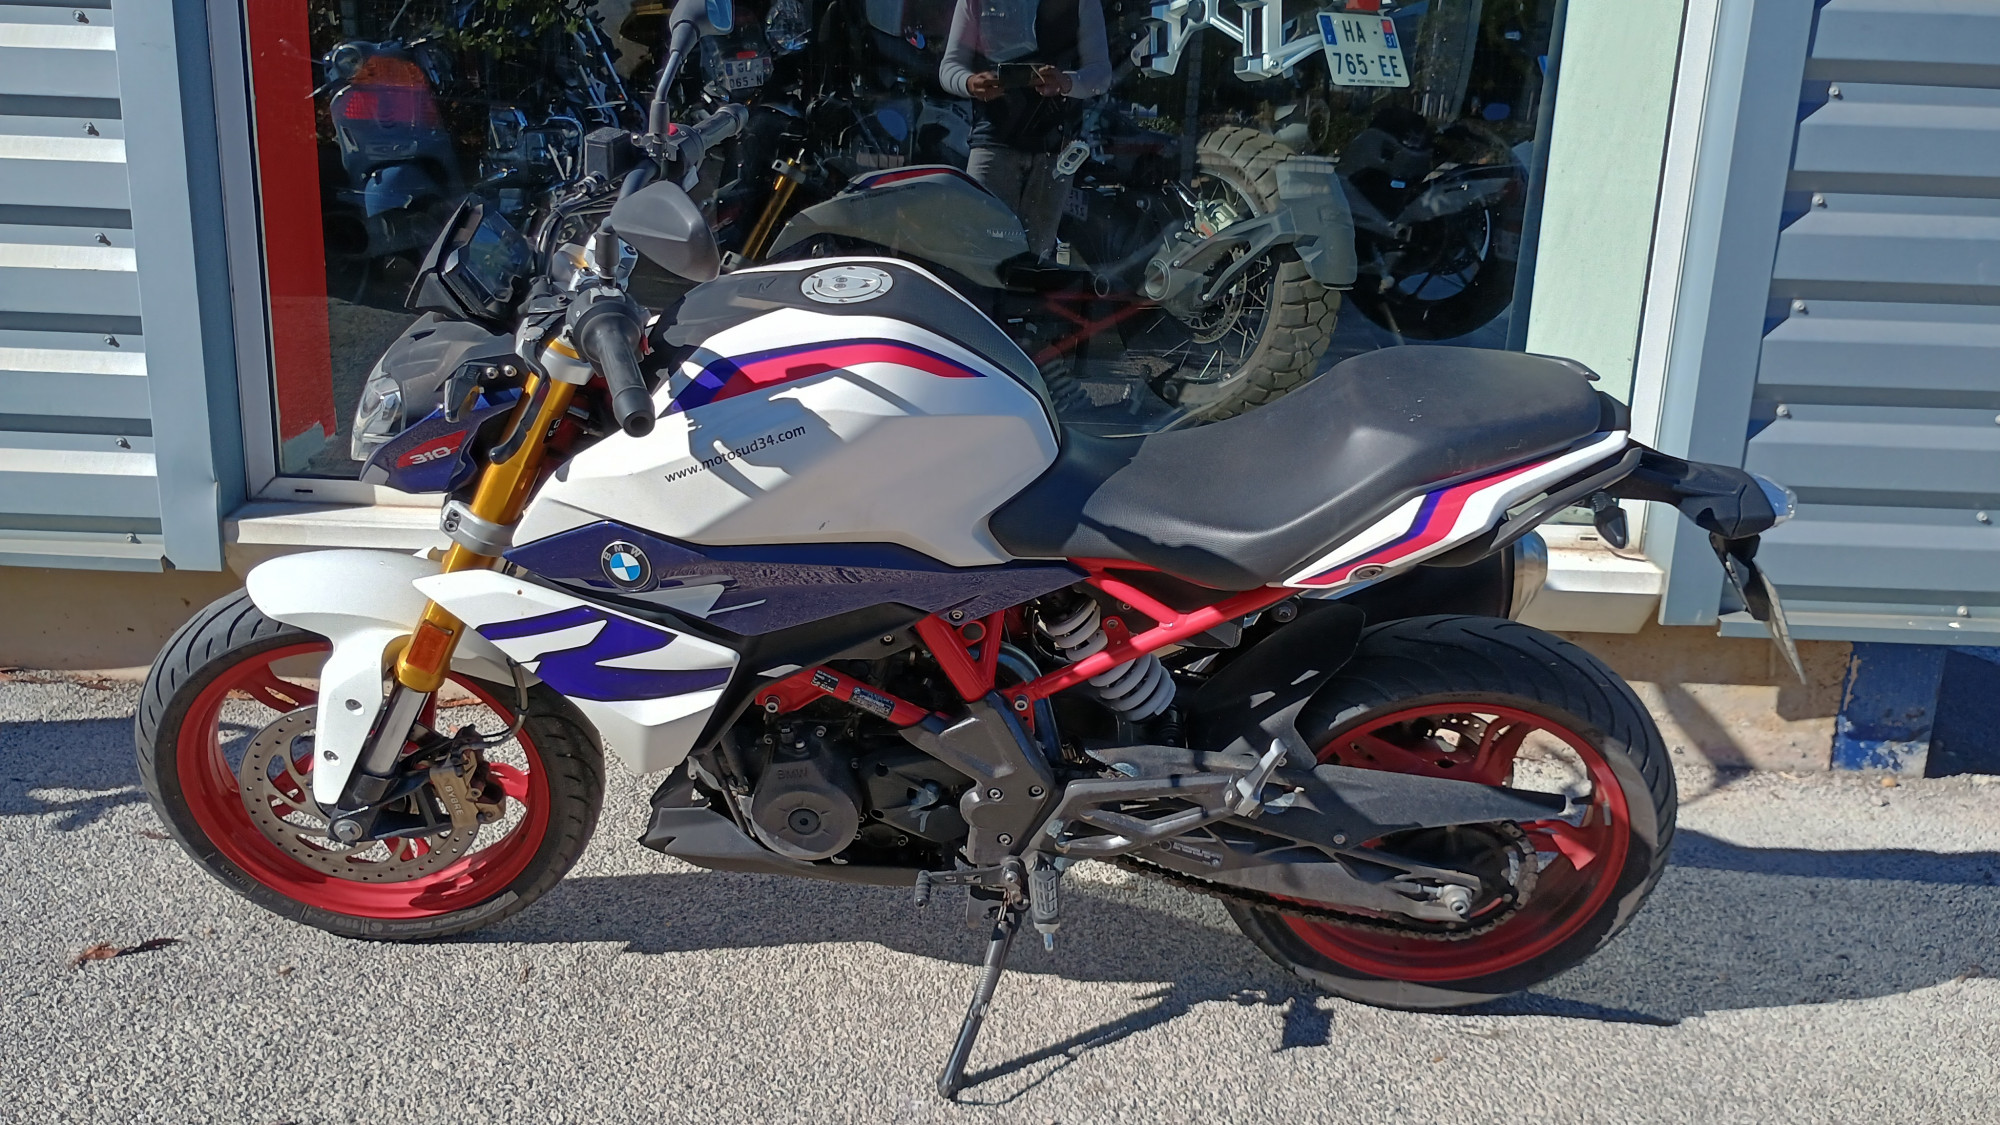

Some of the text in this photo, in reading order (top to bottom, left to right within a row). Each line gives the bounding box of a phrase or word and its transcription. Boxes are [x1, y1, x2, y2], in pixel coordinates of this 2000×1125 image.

[1385, 34, 1397, 47] 31
[1332, 52, 1402, 78] 765-EE
[409, 446, 452, 465] 310
[664, 425, 806, 483] www.motosud34.com
[603, 544, 642, 561] BMW
[777, 766, 808, 780] BMW
[444, 785, 464, 816] BYBRE
